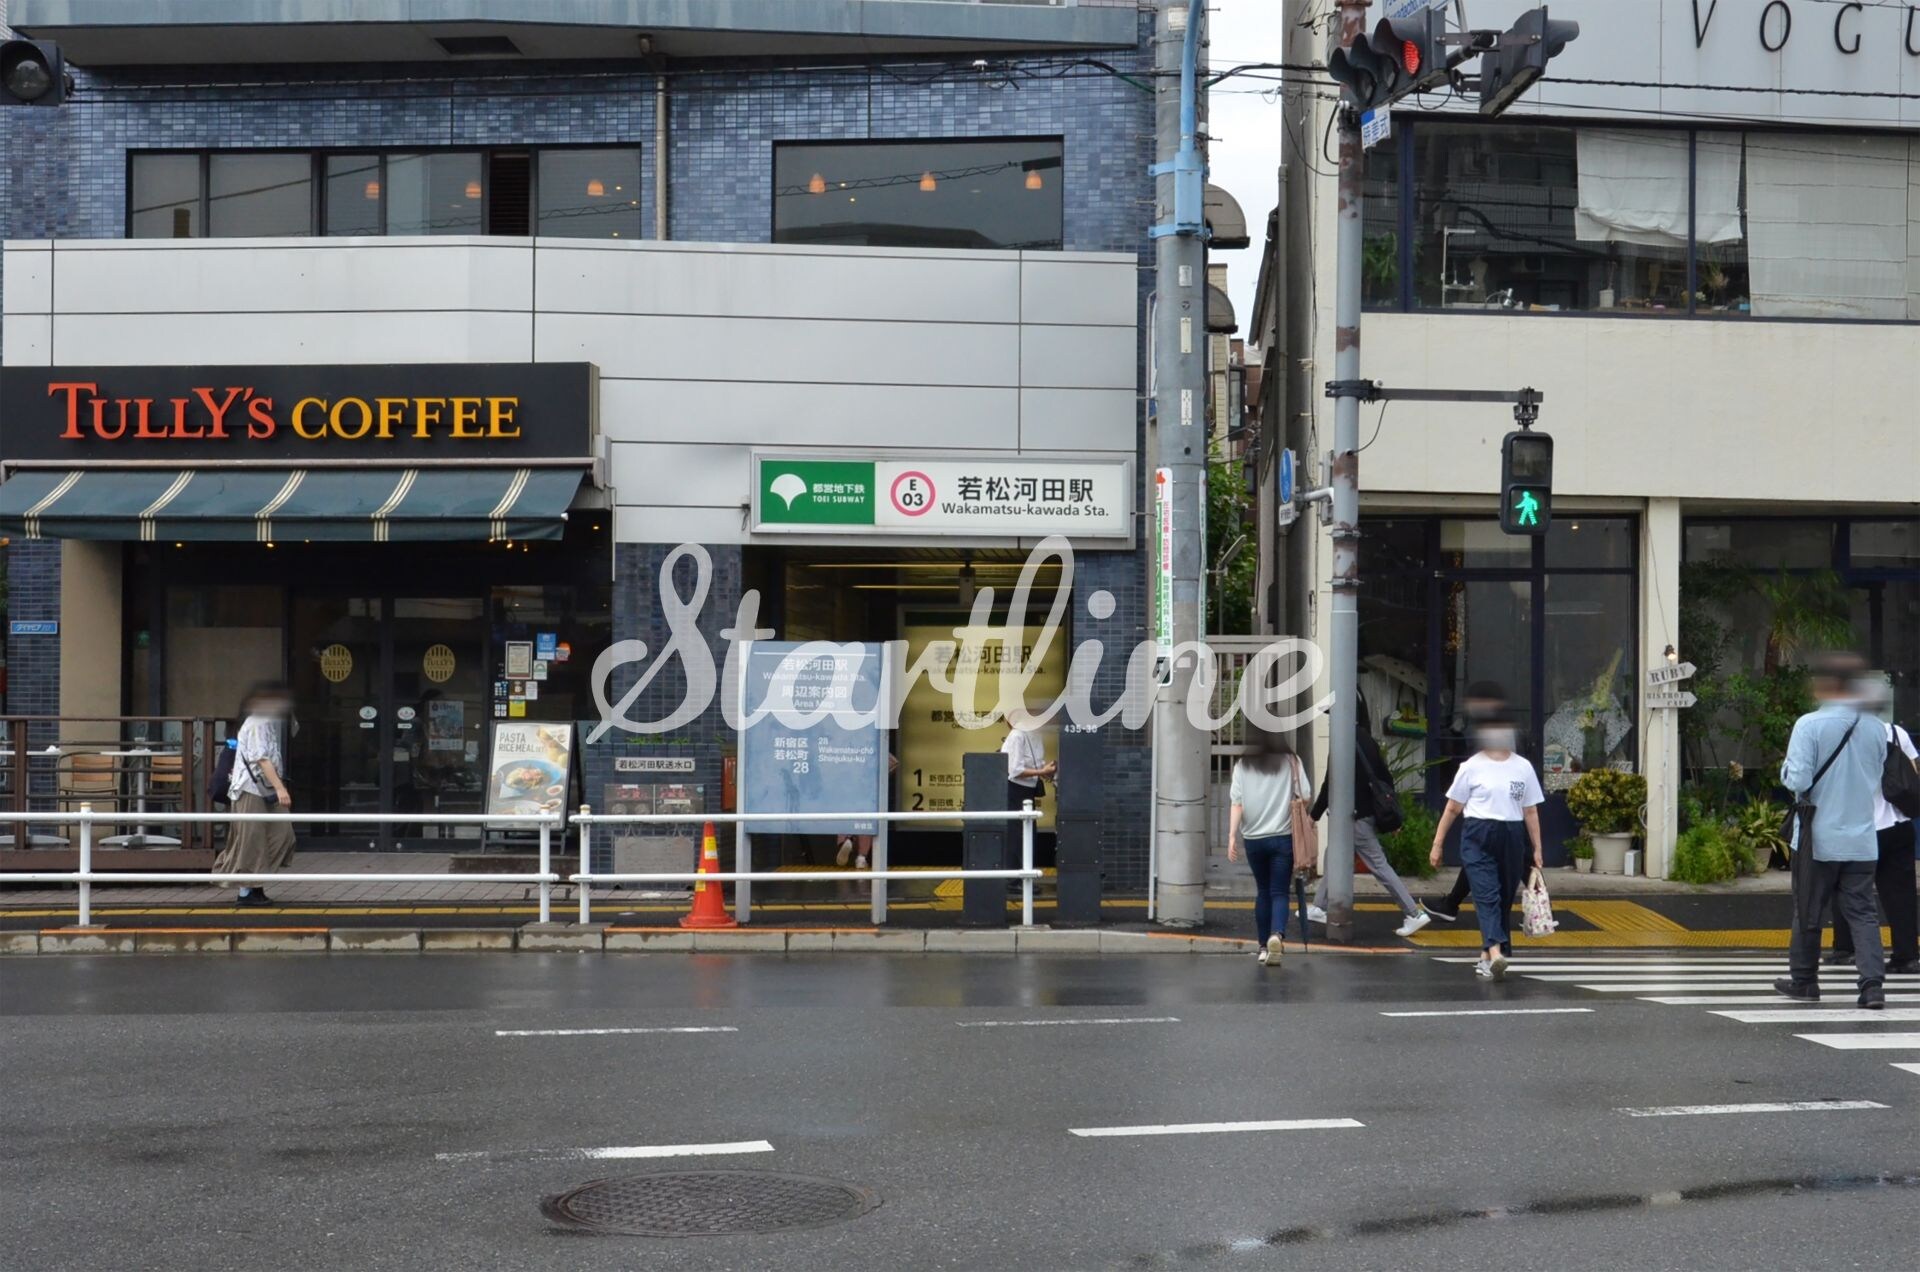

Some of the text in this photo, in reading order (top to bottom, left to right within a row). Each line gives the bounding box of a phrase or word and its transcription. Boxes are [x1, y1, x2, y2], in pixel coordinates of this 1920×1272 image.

[291, 396, 521, 440] COFFEE
[812, 483, 865, 495] 都営地下鉄
[909, 479, 917, 491] E
[957, 476, 1094, 502] 若松河田駅
[812, 495, 865, 504] TOEI SUBWAY
[902, 493, 924, 507] 03
[941, 502, 1110, 517] Wakamatsu-kawada Sta.
[934, 645, 1032, 664] 若松河田駅
[782, 659, 848, 671] 若松河田駅
[1650, 665, 1688, 683] RUBY
[499, 732, 527, 743] PASTA
[774, 737, 809, 748] 新宿区
[498, 744, 515, 752] RICE
[515, 744, 534, 752] MEAL
[774, 749, 809, 761] 若松町
[619, 759, 693, 770] 若松河田駅送水口
[792, 762, 810, 774] 28
[913, 769, 922, 787] 1
[912, 793, 924, 811] 2
